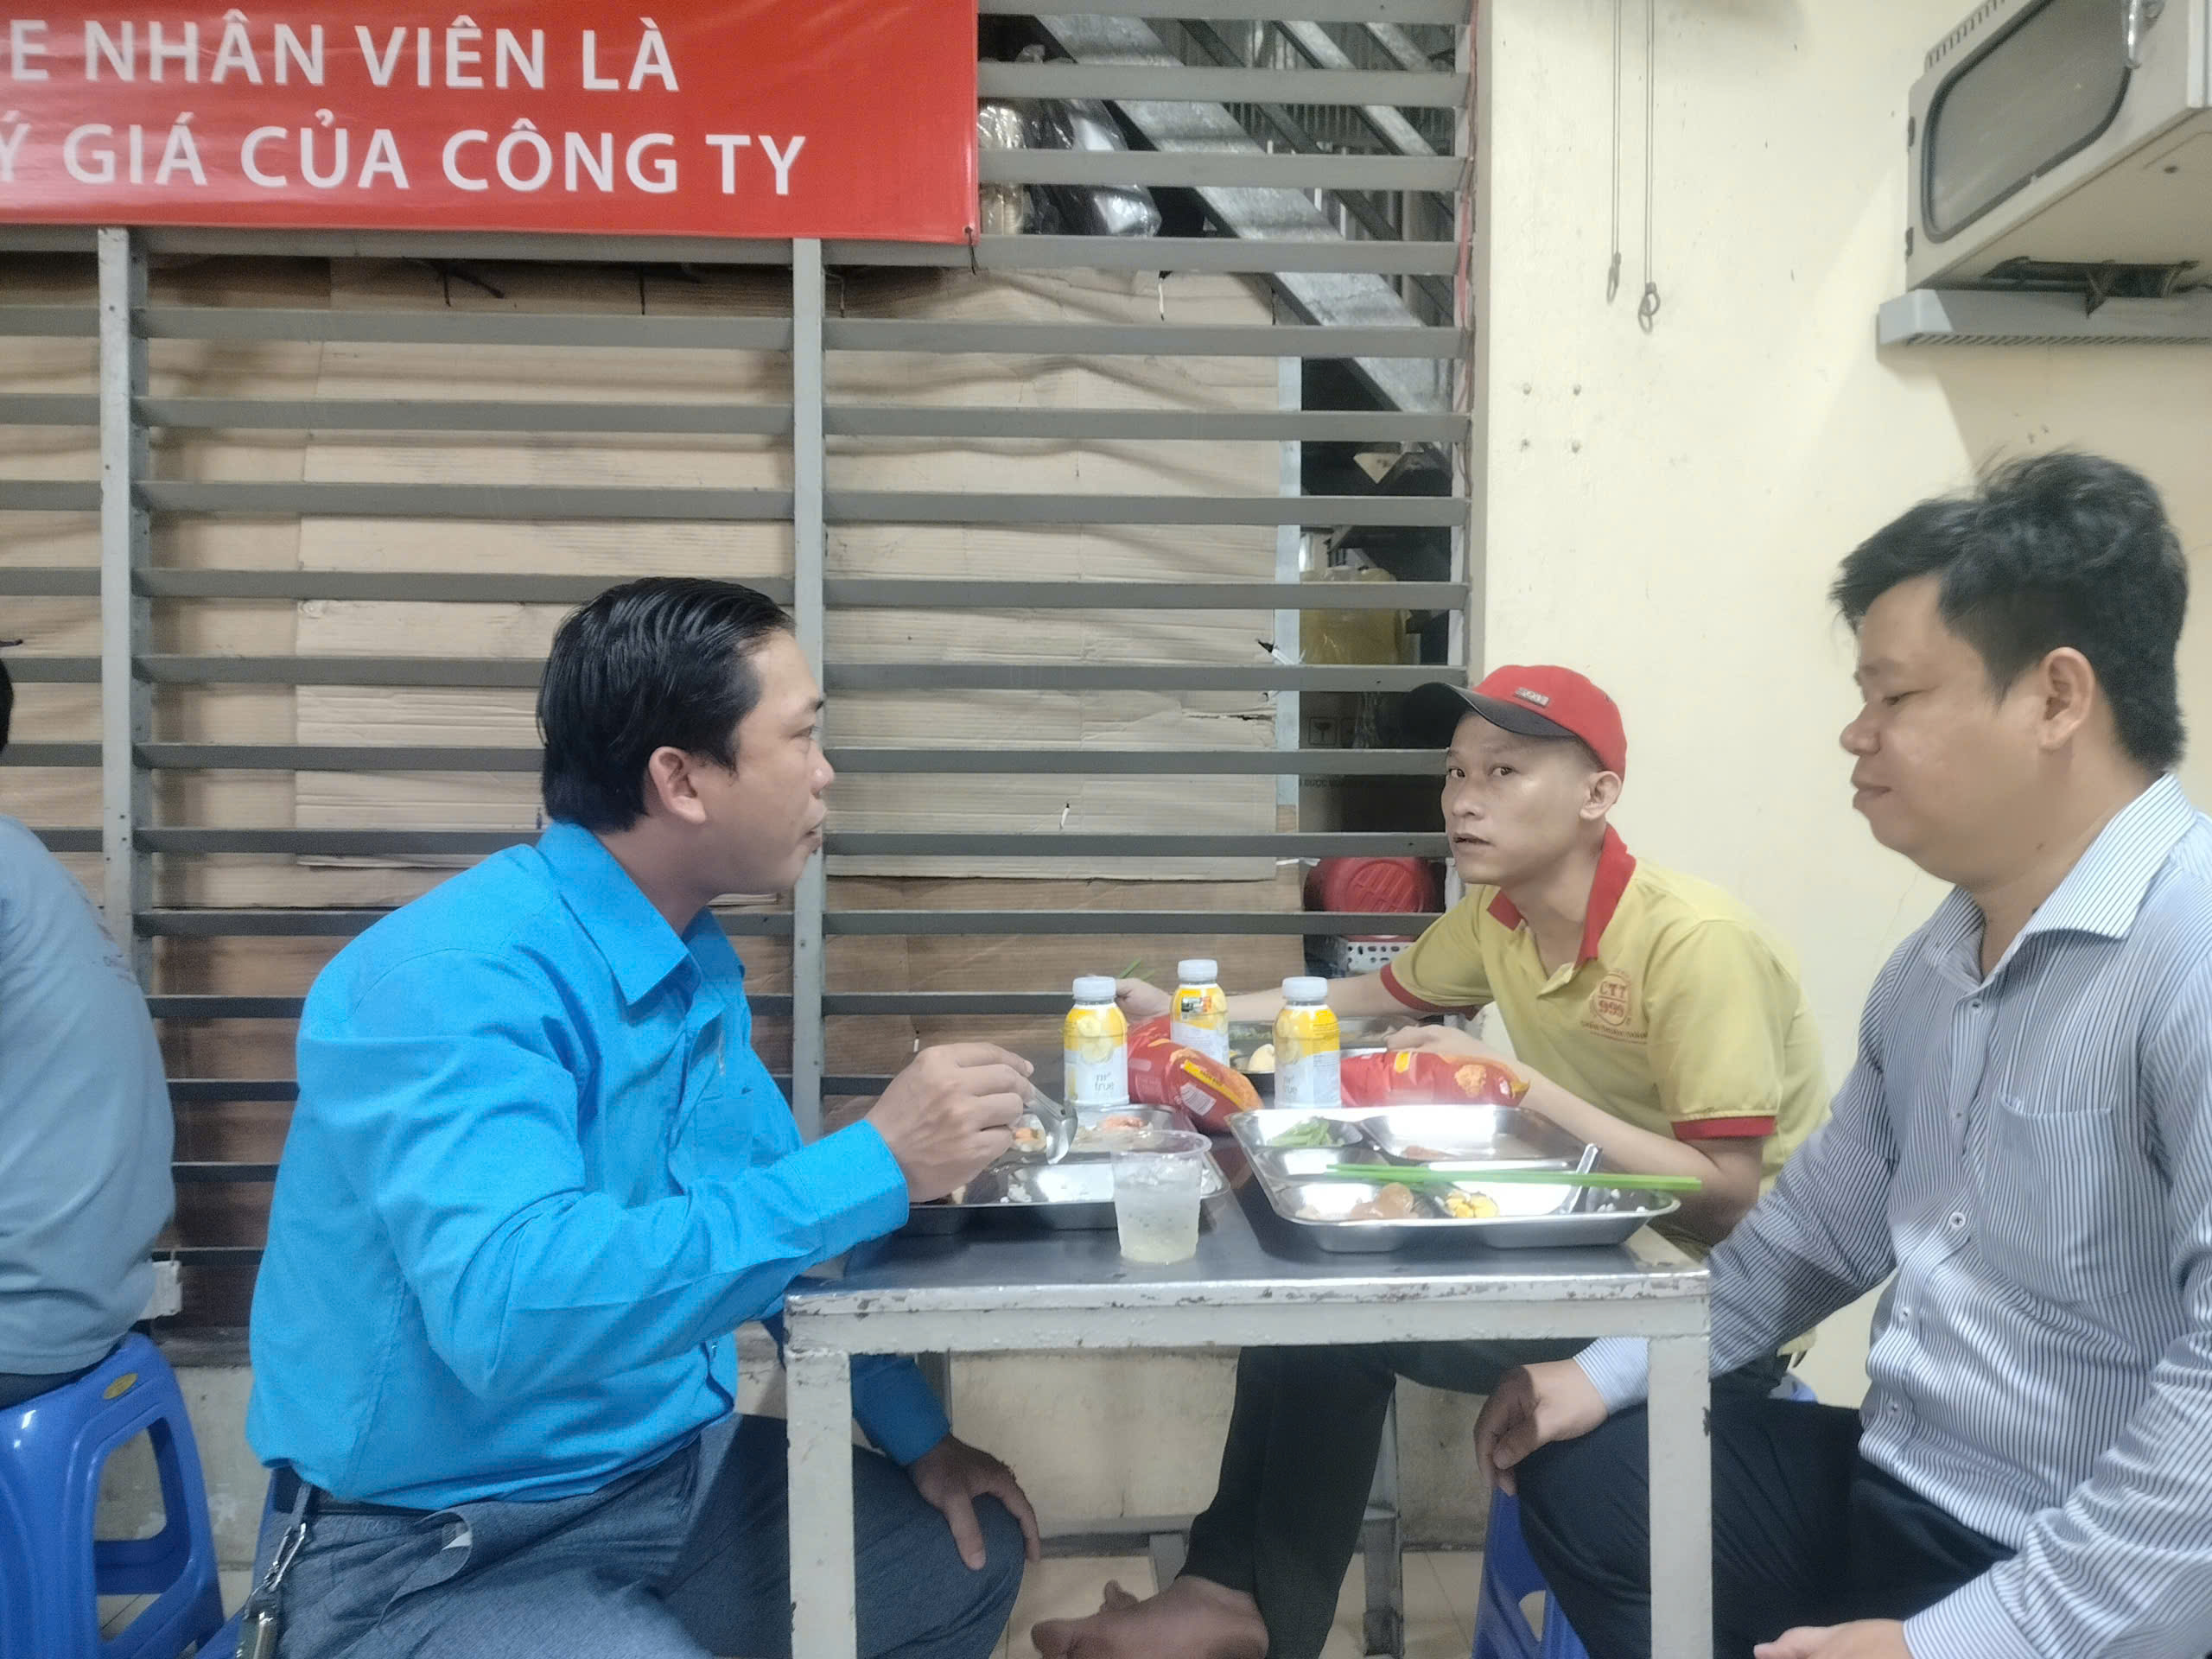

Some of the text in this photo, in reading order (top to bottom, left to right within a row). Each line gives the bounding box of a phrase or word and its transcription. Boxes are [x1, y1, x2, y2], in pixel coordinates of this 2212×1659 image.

[10, 10, 680, 92] E NHÂN VIÊN LÀ
[0, 110, 806, 195] Ý GIÁ CỦA CÔNG TY
